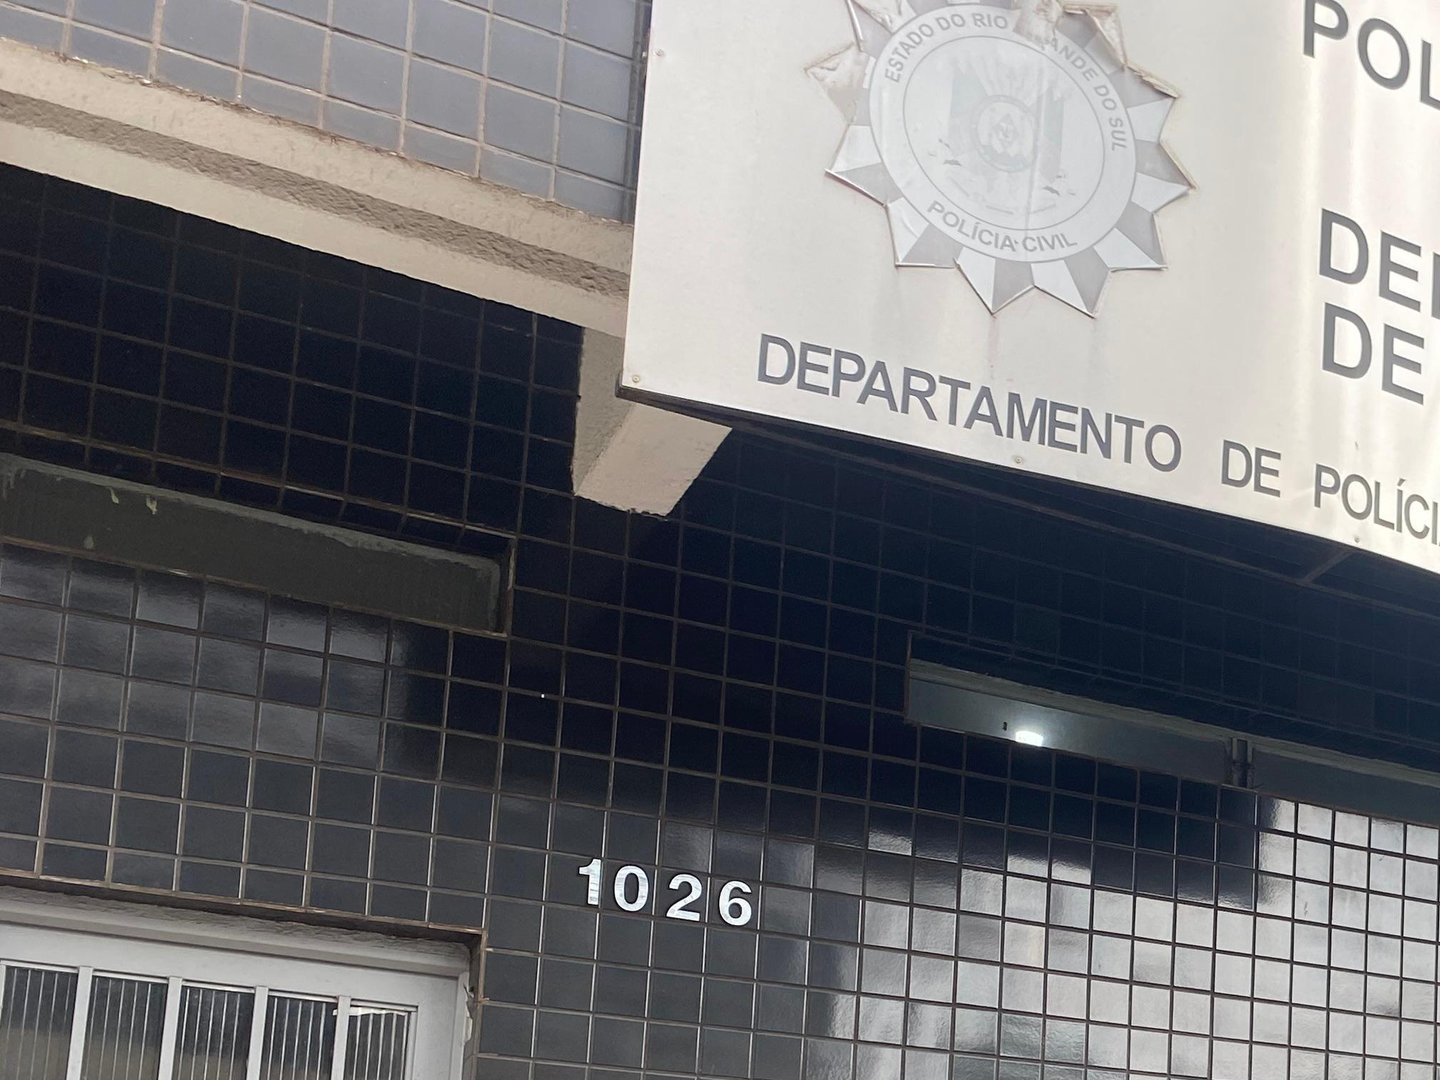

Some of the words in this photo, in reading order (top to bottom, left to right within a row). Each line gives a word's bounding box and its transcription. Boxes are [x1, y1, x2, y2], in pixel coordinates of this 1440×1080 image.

[884, 22, 935, 83] ESTADO
[935, 13, 966, 32] DO
[971, 12, 1008, 29] RIO
[1093, 84, 1117, 112] DO
[1108, 116, 1128, 151] SUL
[927, 200, 1016, 252] POLÍCIA
[1021, 232, 1078, 253] CIVIL
[1321, 301, 1425, 406] DE
[756, 332, 1183, 474] DEPARTAMENTO
[1220, 438, 1283, 498] DE
[577, 857, 754, 927] 1026
